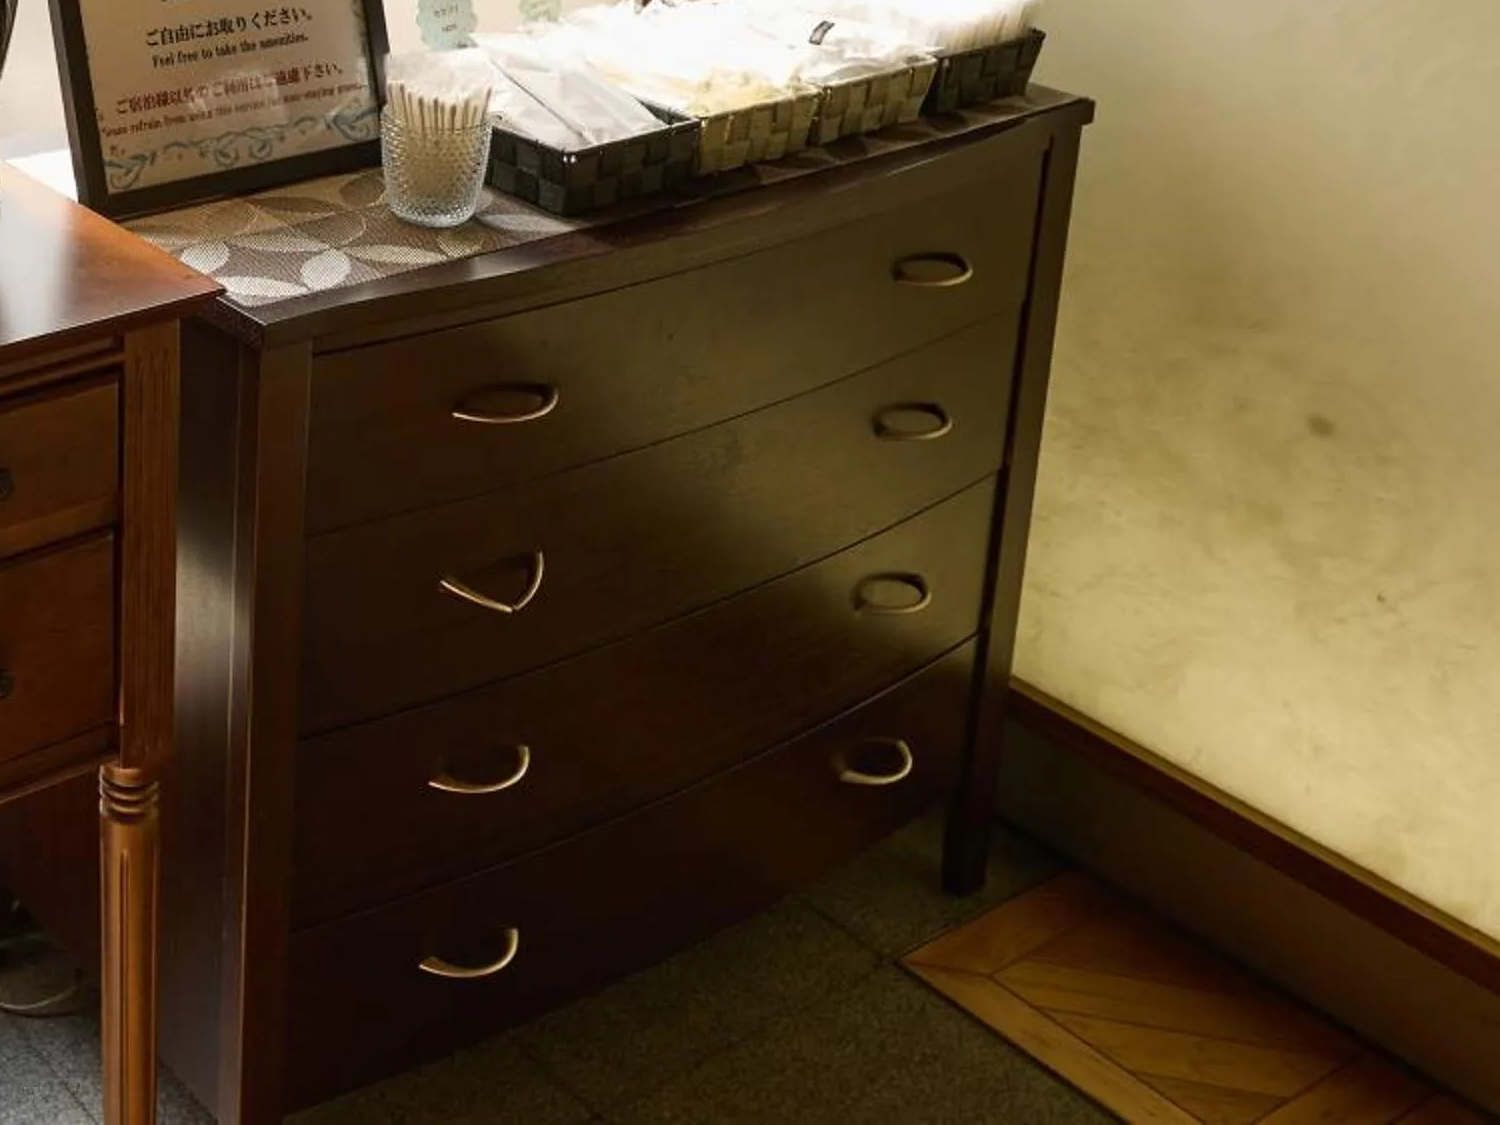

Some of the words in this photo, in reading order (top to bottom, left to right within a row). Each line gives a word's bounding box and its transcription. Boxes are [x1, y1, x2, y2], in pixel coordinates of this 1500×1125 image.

[146, 6, 313, 47] ご自由にお取りください。
[151, 51, 174, 68] Feel
[177, 49, 199, 63] free
[201, 48, 213, 60] to
[215, 43, 238, 57] take
[239, 39, 257, 53] the
